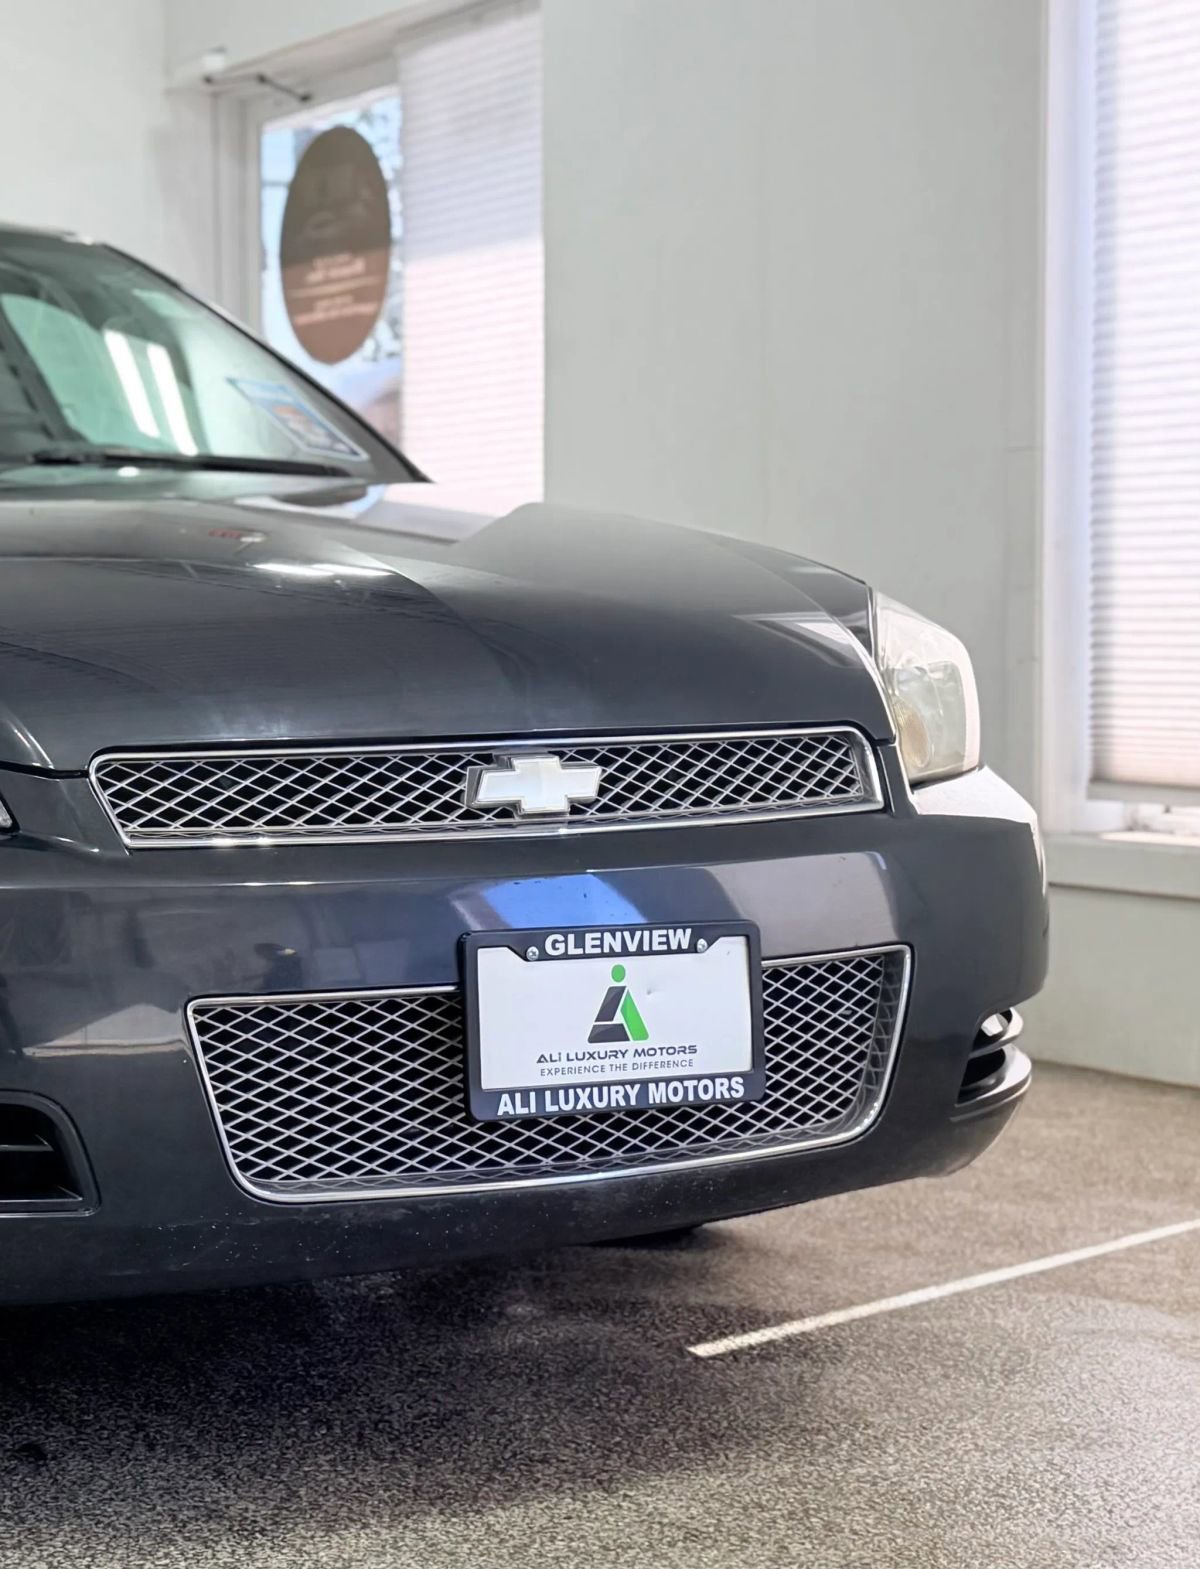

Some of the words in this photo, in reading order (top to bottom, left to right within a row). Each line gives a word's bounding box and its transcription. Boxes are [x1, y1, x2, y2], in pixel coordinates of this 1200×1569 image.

[544, 928, 692, 956] GLENVIEW
[567, 1049, 629, 1062] LUXURY
[633, 1045, 698, 1058] MOTORS
[540, 1064, 606, 1077] EXPERIENCE
[609, 1063, 628, 1073] THE
[632, 1059, 694, 1071] DIFFERENCE
[497, 1092, 537, 1116] ALI
[545, 1083, 640, 1112] LUXURY
[648, 1076, 745, 1105] MOTORS
